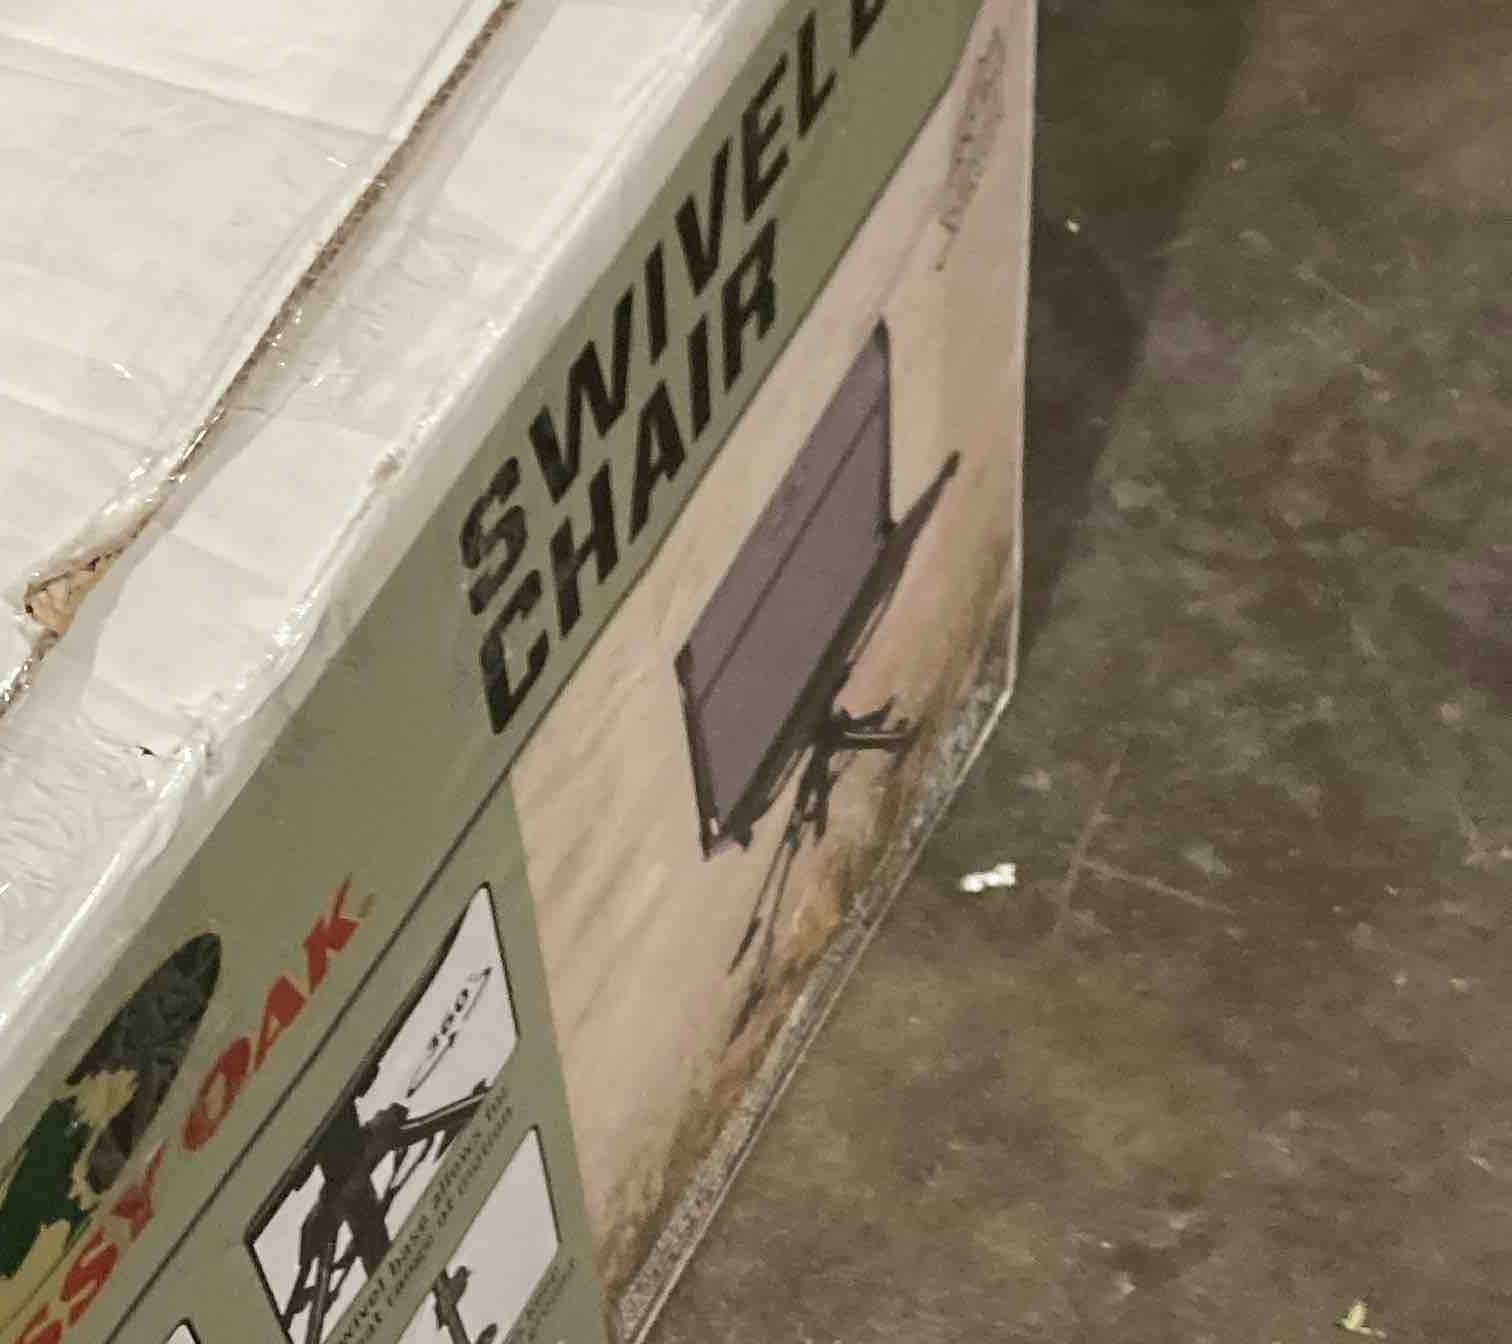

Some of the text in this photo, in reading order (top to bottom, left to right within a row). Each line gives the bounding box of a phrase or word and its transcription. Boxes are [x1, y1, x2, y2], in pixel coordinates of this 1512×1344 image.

[458, 11, 838, 618] SWIVEL
[480, 218, 779, 736] CHAIR
[180, 870, 360, 1152] OAK
[388, 1215, 430, 1276] base
[432, 1131, 482, 1208] allows
